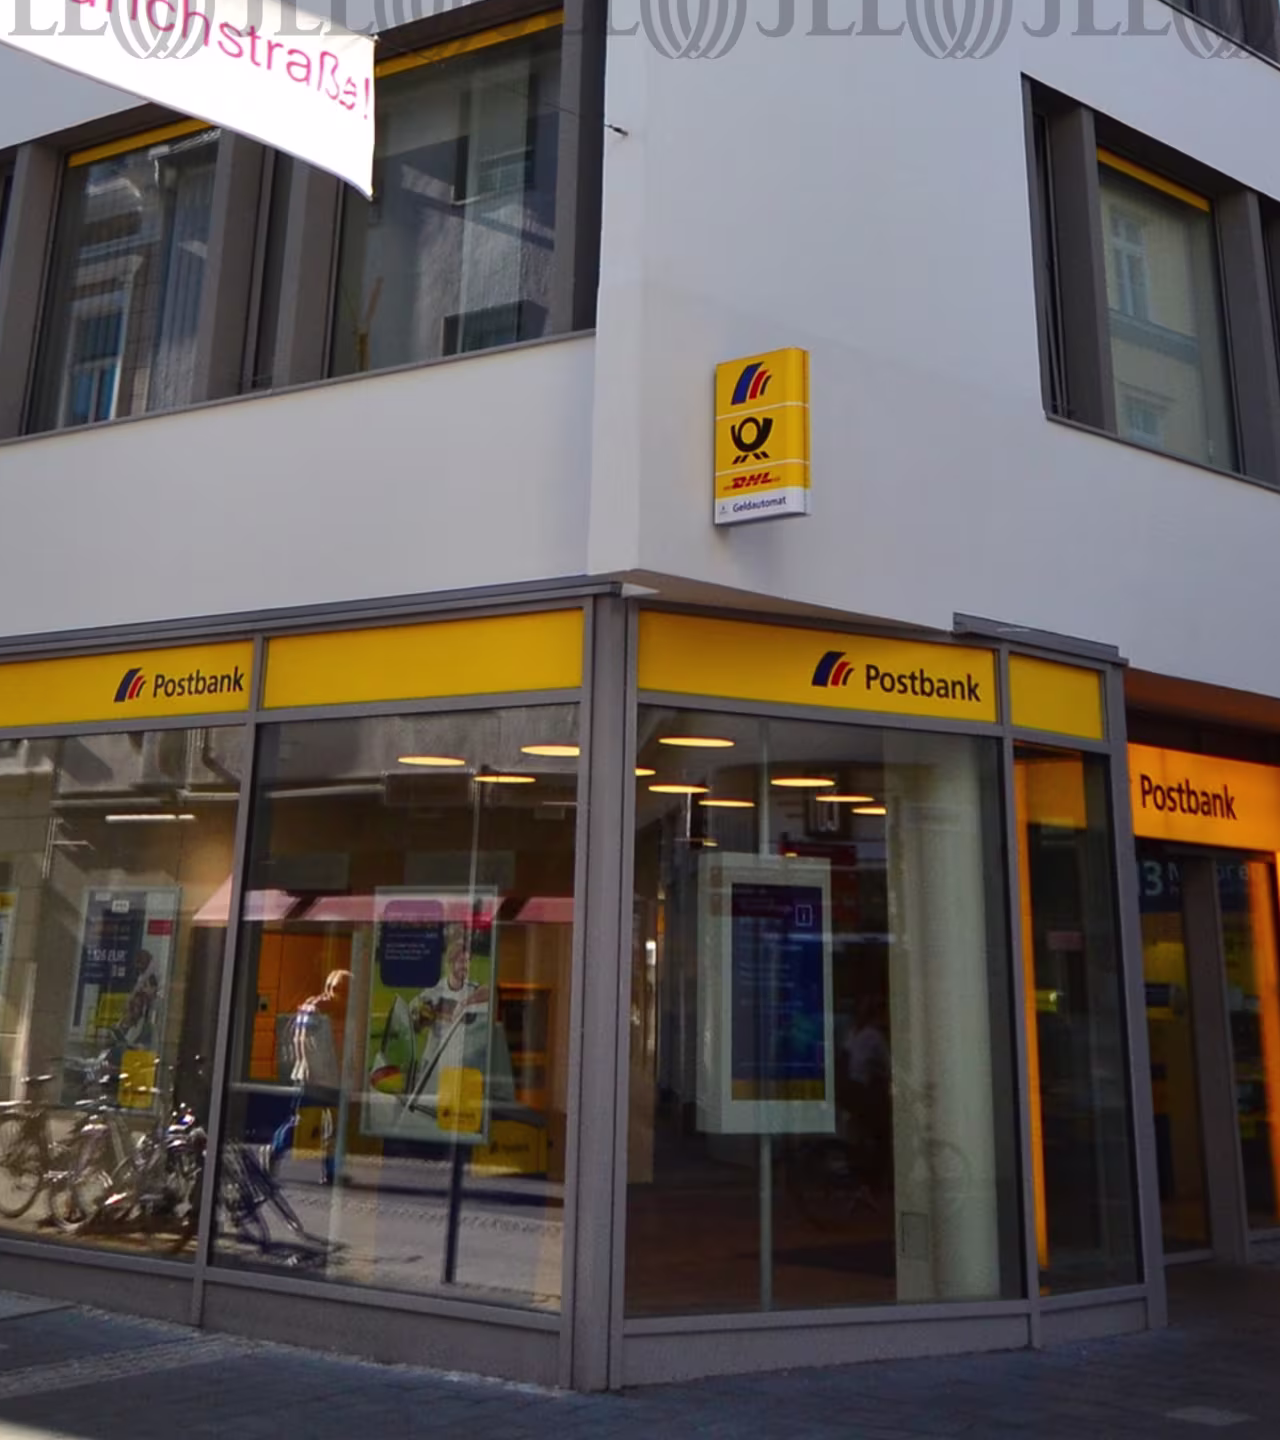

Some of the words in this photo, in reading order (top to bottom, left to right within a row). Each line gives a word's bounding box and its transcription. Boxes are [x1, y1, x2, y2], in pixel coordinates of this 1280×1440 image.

[732, 471, 772, 489] DHL
[732, 496, 787, 513] Geldautomat
[152, 665, 245, 699] Postbank
[865, 663, 982, 703] Postbank
[1140, 774, 1238, 821] Postbank
